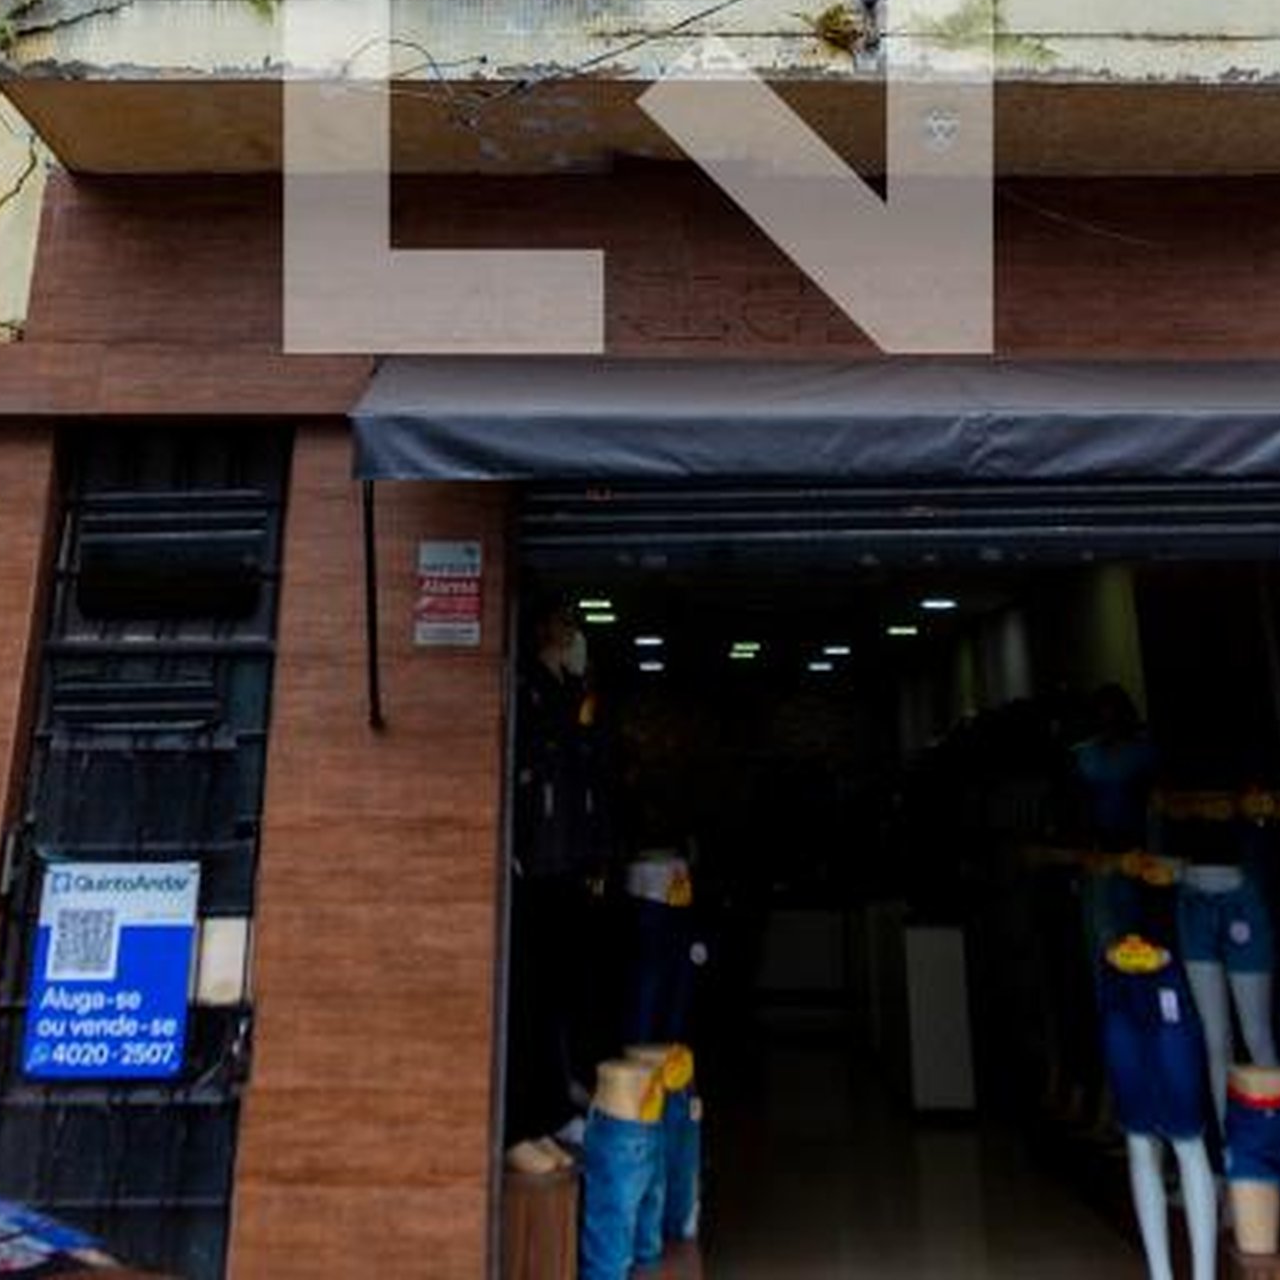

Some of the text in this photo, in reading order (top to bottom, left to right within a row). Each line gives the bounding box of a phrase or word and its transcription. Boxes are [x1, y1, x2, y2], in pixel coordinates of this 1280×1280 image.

[73, 872, 190, 896] QuintoAndar
[39, 987, 141, 1014] Aluga-se
[37, 1014, 178, 1038] ou vende-se
